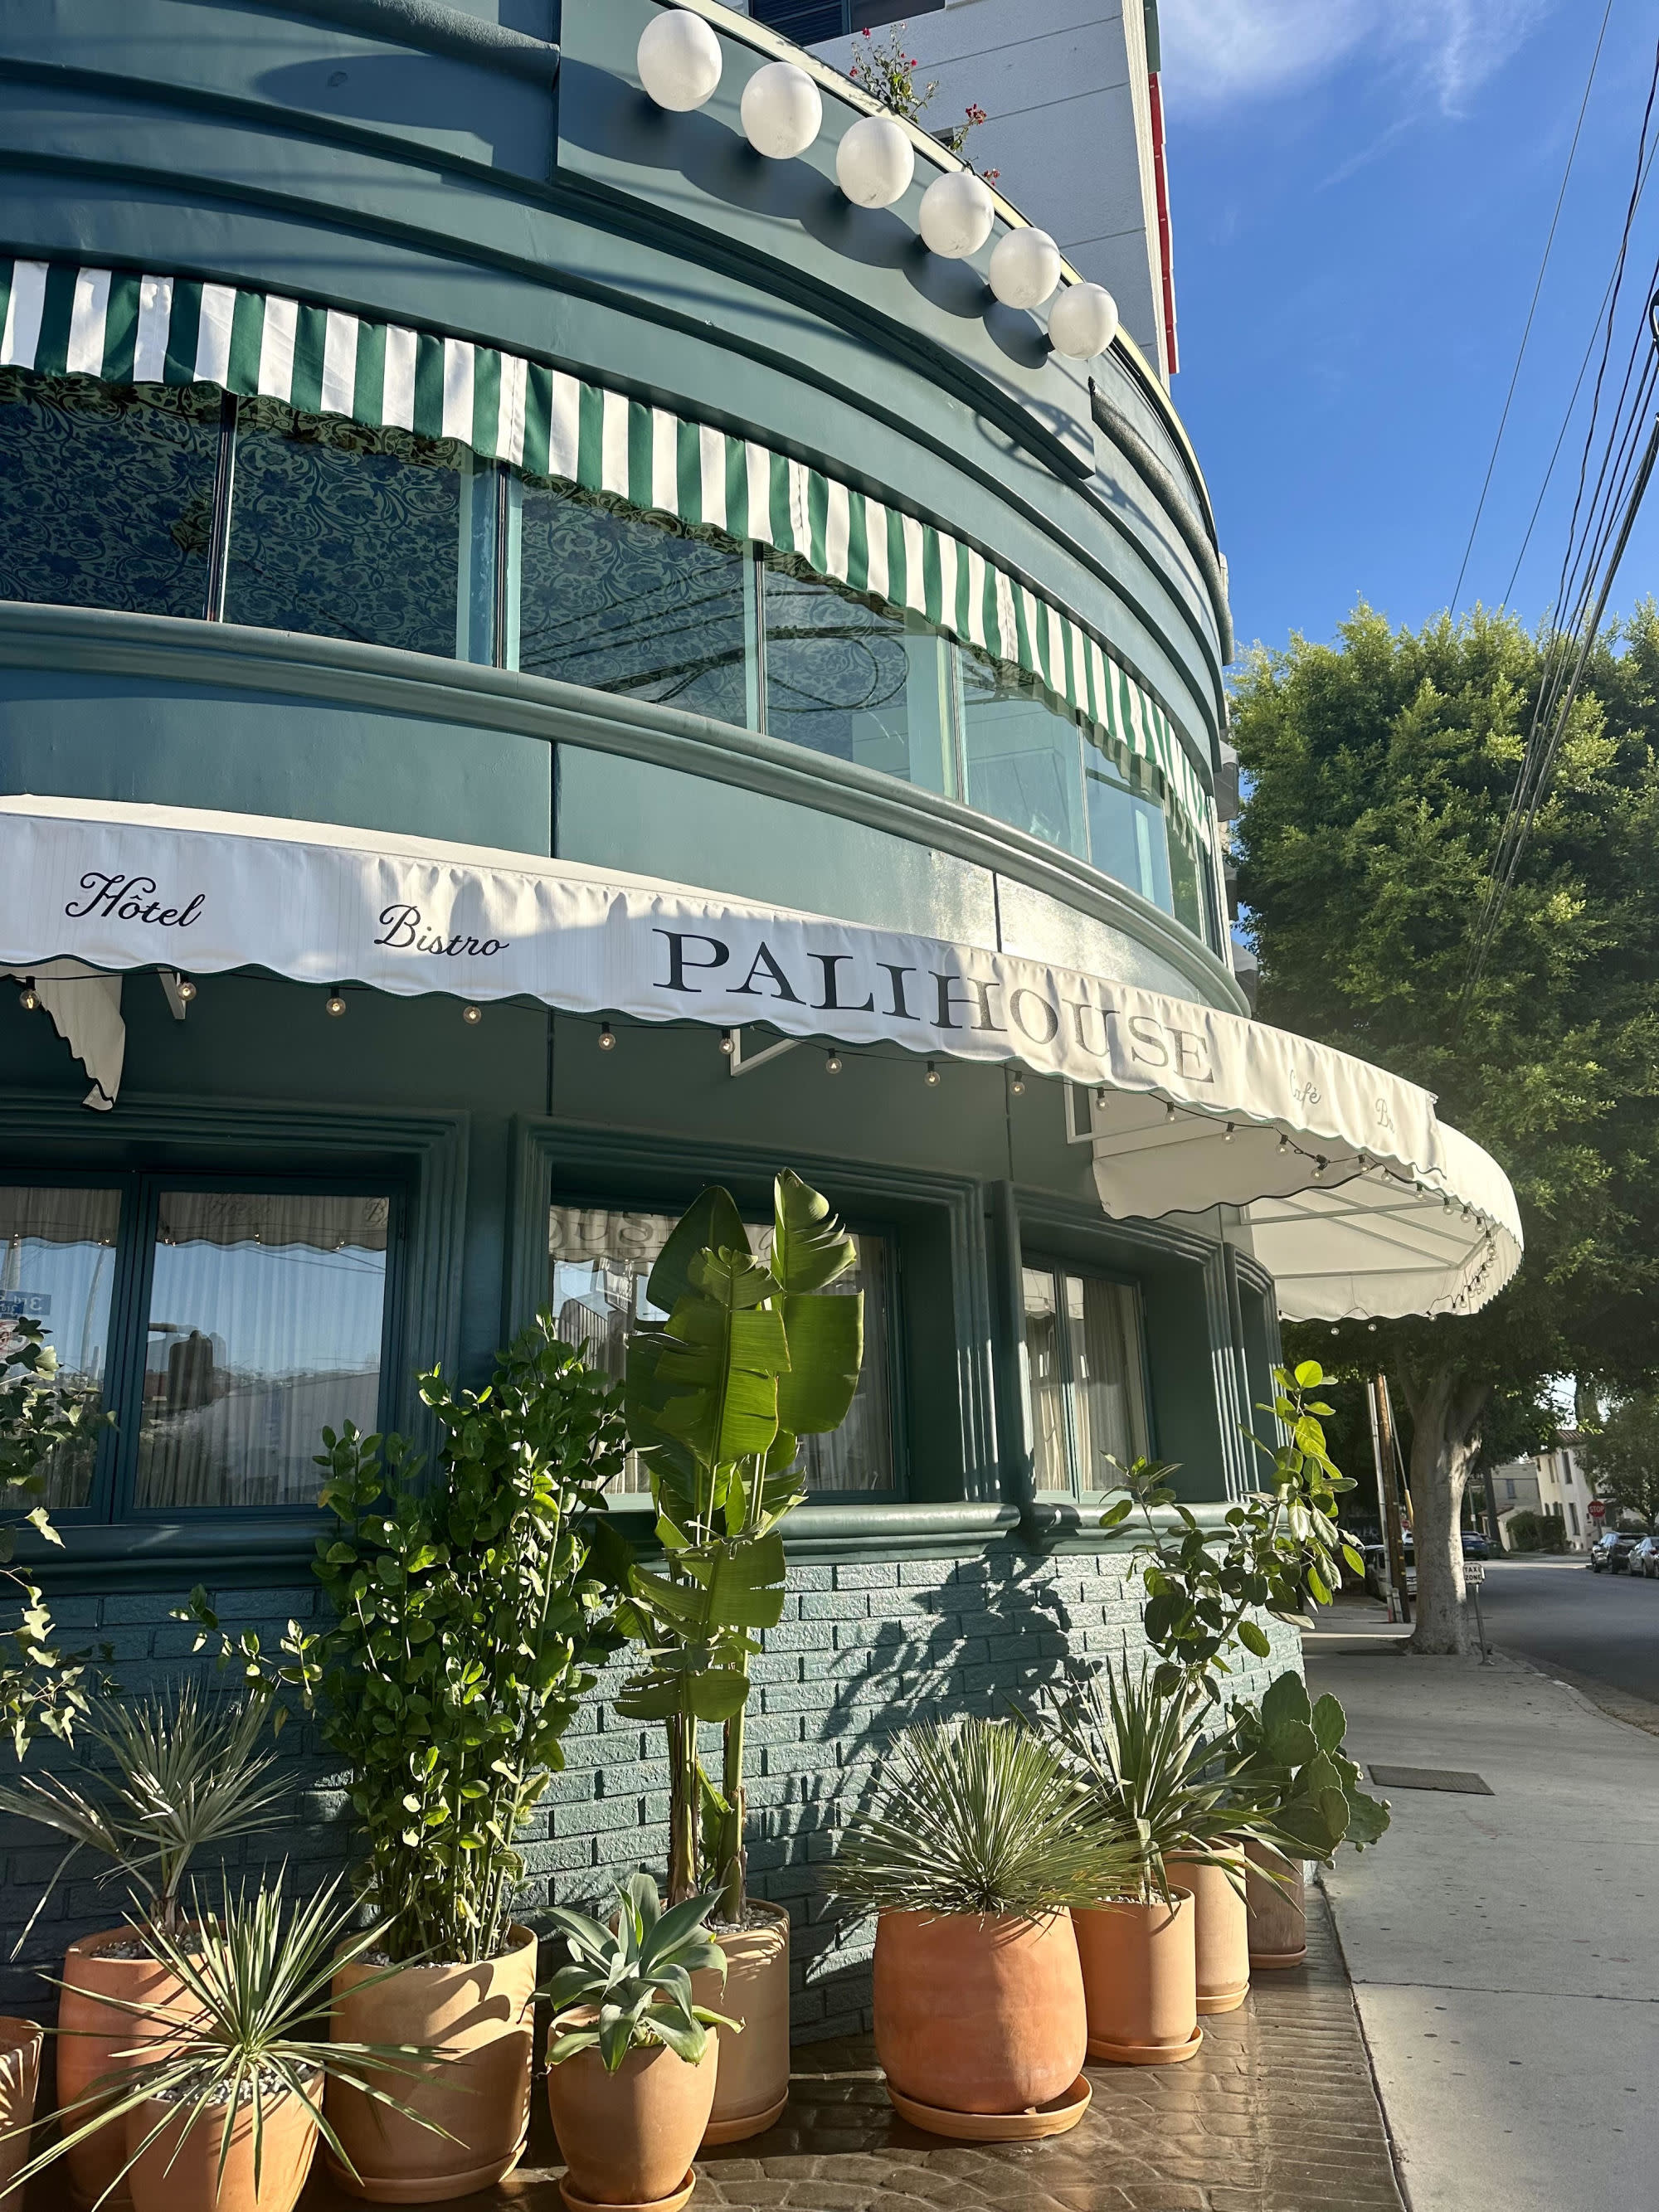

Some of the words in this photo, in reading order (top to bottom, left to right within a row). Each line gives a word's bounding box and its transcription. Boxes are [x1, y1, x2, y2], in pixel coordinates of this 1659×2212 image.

[65, 872, 206, 927] Hôtel
[373, 903, 510, 956] Bistro
[652, 927, 1215, 1084] PALIHOUSE
